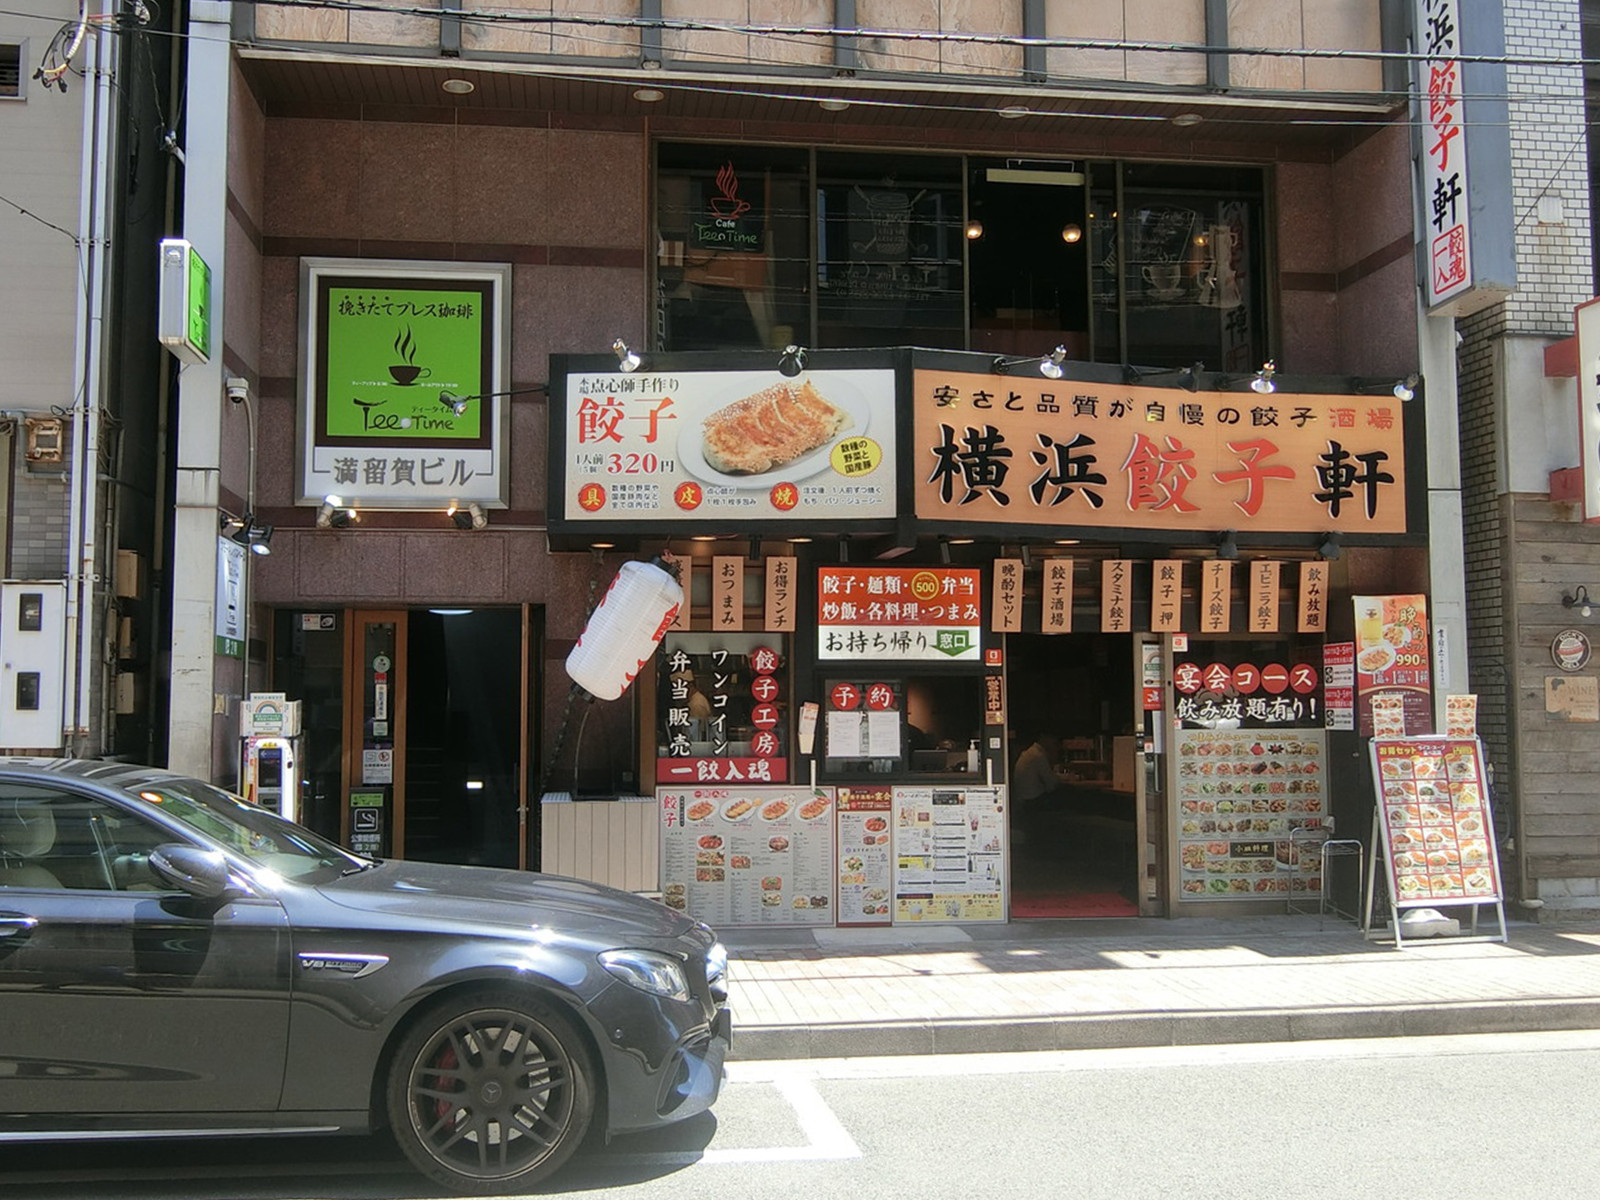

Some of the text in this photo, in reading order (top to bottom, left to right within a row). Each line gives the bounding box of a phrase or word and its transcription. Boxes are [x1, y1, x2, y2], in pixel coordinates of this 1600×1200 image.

[1422, 0, 1463, 233] 浜餃子軒
[715, 219, 736, 228] Cafe
[726, 230, 758, 244] Time
[590, 377, 680, 394] 点心師手作り
[933, 385, 1395, 430] 安さと品質が自慢の餃子酒場
[353, 397, 455, 432] Tee Time
[576, 396, 678, 444] 餃子
[334, 457, 474, 487] 満留賀ビル
[927, 423, 1396, 521] 横浜餃子軒
[721, 563, 736, 626] おつまみ
[773, 561, 789, 629] お得ランチ
[822, 602, 979, 621] 炒飯・各料理・つまみ
[1001, 564, 1016, 629] 晩酌セット
[1050, 566, 1066, 627] 餃子酒場
[1109, 562, 1124, 631] スタミナ餃子
[1160, 566, 1175, 626] 餃子一押
[1209, 563, 1224, 630] チーズ餃子
[1257, 563, 1272, 630] エビニラ餃子
[1306, 567, 1322, 627] 飲み放題
[826, 630, 928, 654] お持ち帰り
[939, 633, 968, 649] 窓口
[755, 649, 777, 755] 餃子工房
[835, 686, 890, 708] 予約
[1175, 665, 1313, 691] 宴会コース
[668, 650, 692, 757] 弁当販売
[711, 650, 729, 755] ワンコイン
[670, 759, 772, 782] 一餃入魂
[663, 795, 678, 828] 餃子
[302, 959, 326, 969] V8
